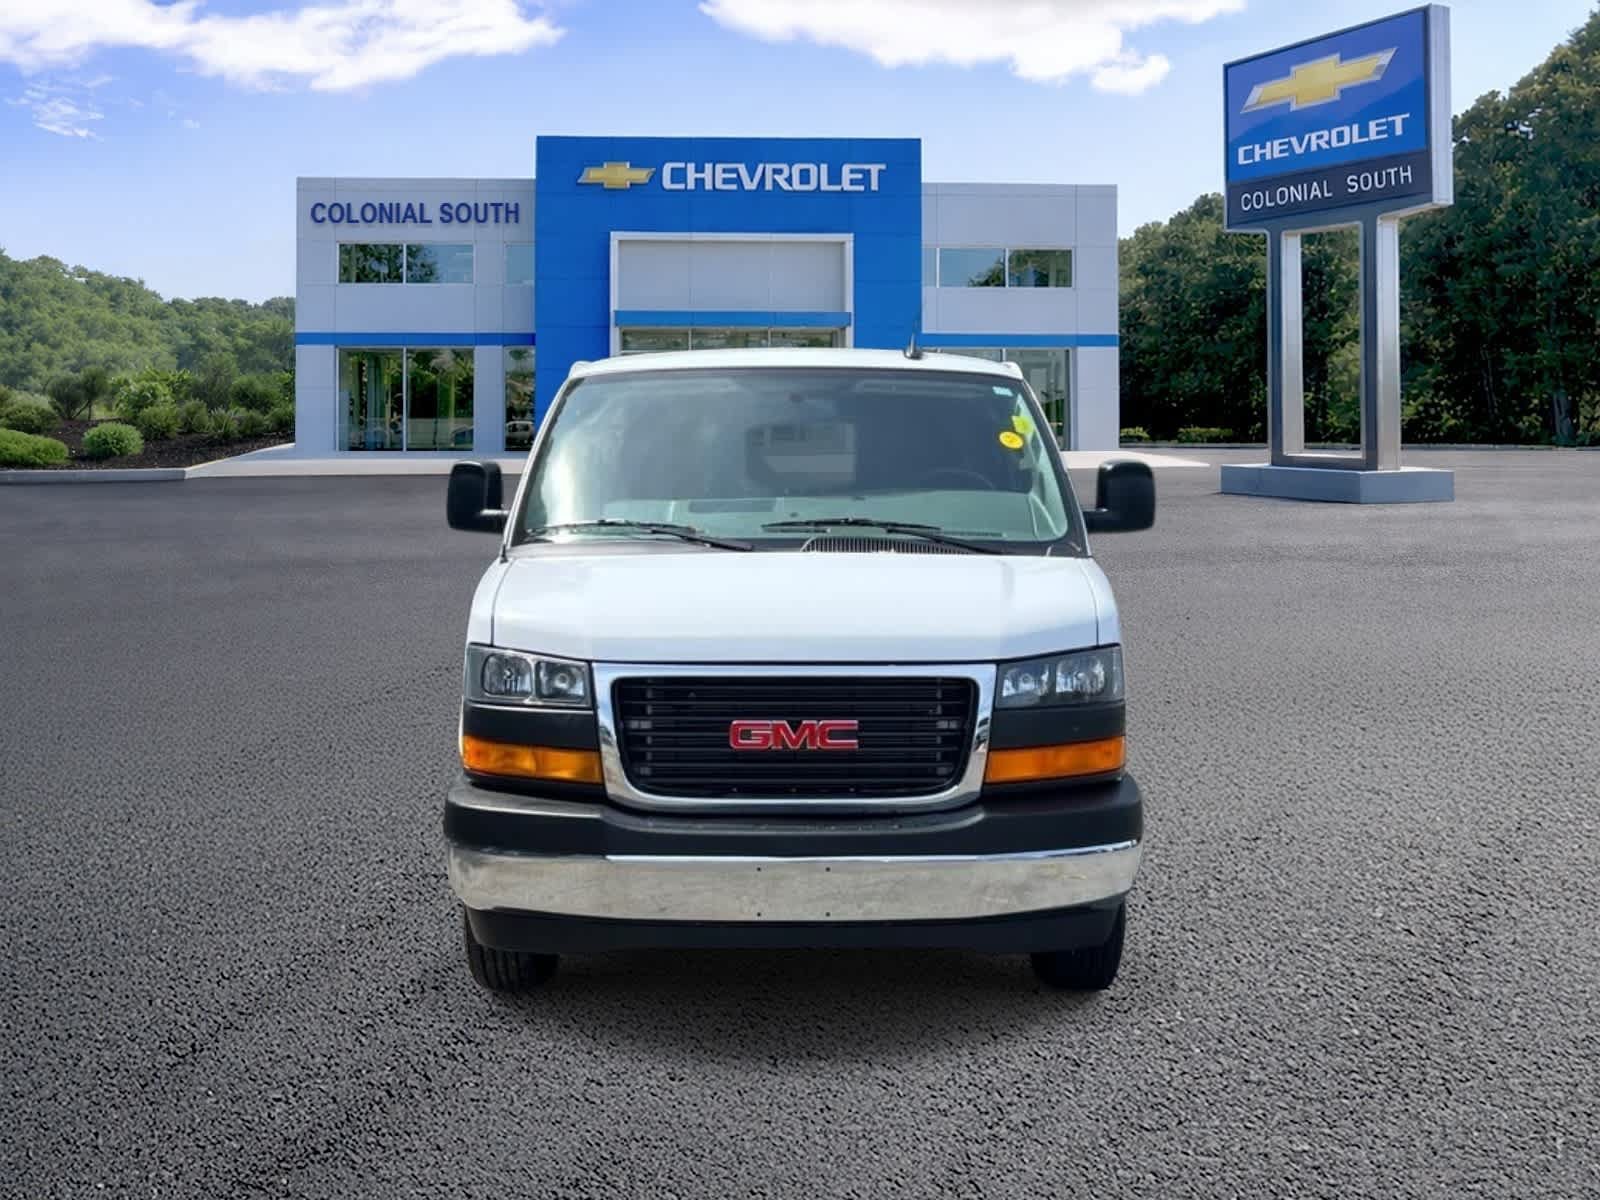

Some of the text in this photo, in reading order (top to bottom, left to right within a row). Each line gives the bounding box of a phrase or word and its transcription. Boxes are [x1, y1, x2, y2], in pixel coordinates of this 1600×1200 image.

[1238, 113, 1410, 165] CHEVROLET
[661, 162, 886, 192] CHEVROLET
[1241, 166, 1412, 211] COLONIAL SOUTH
[310, 202, 520, 225] COLONIAL SOUTH
[730, 720, 859, 750] GMC
